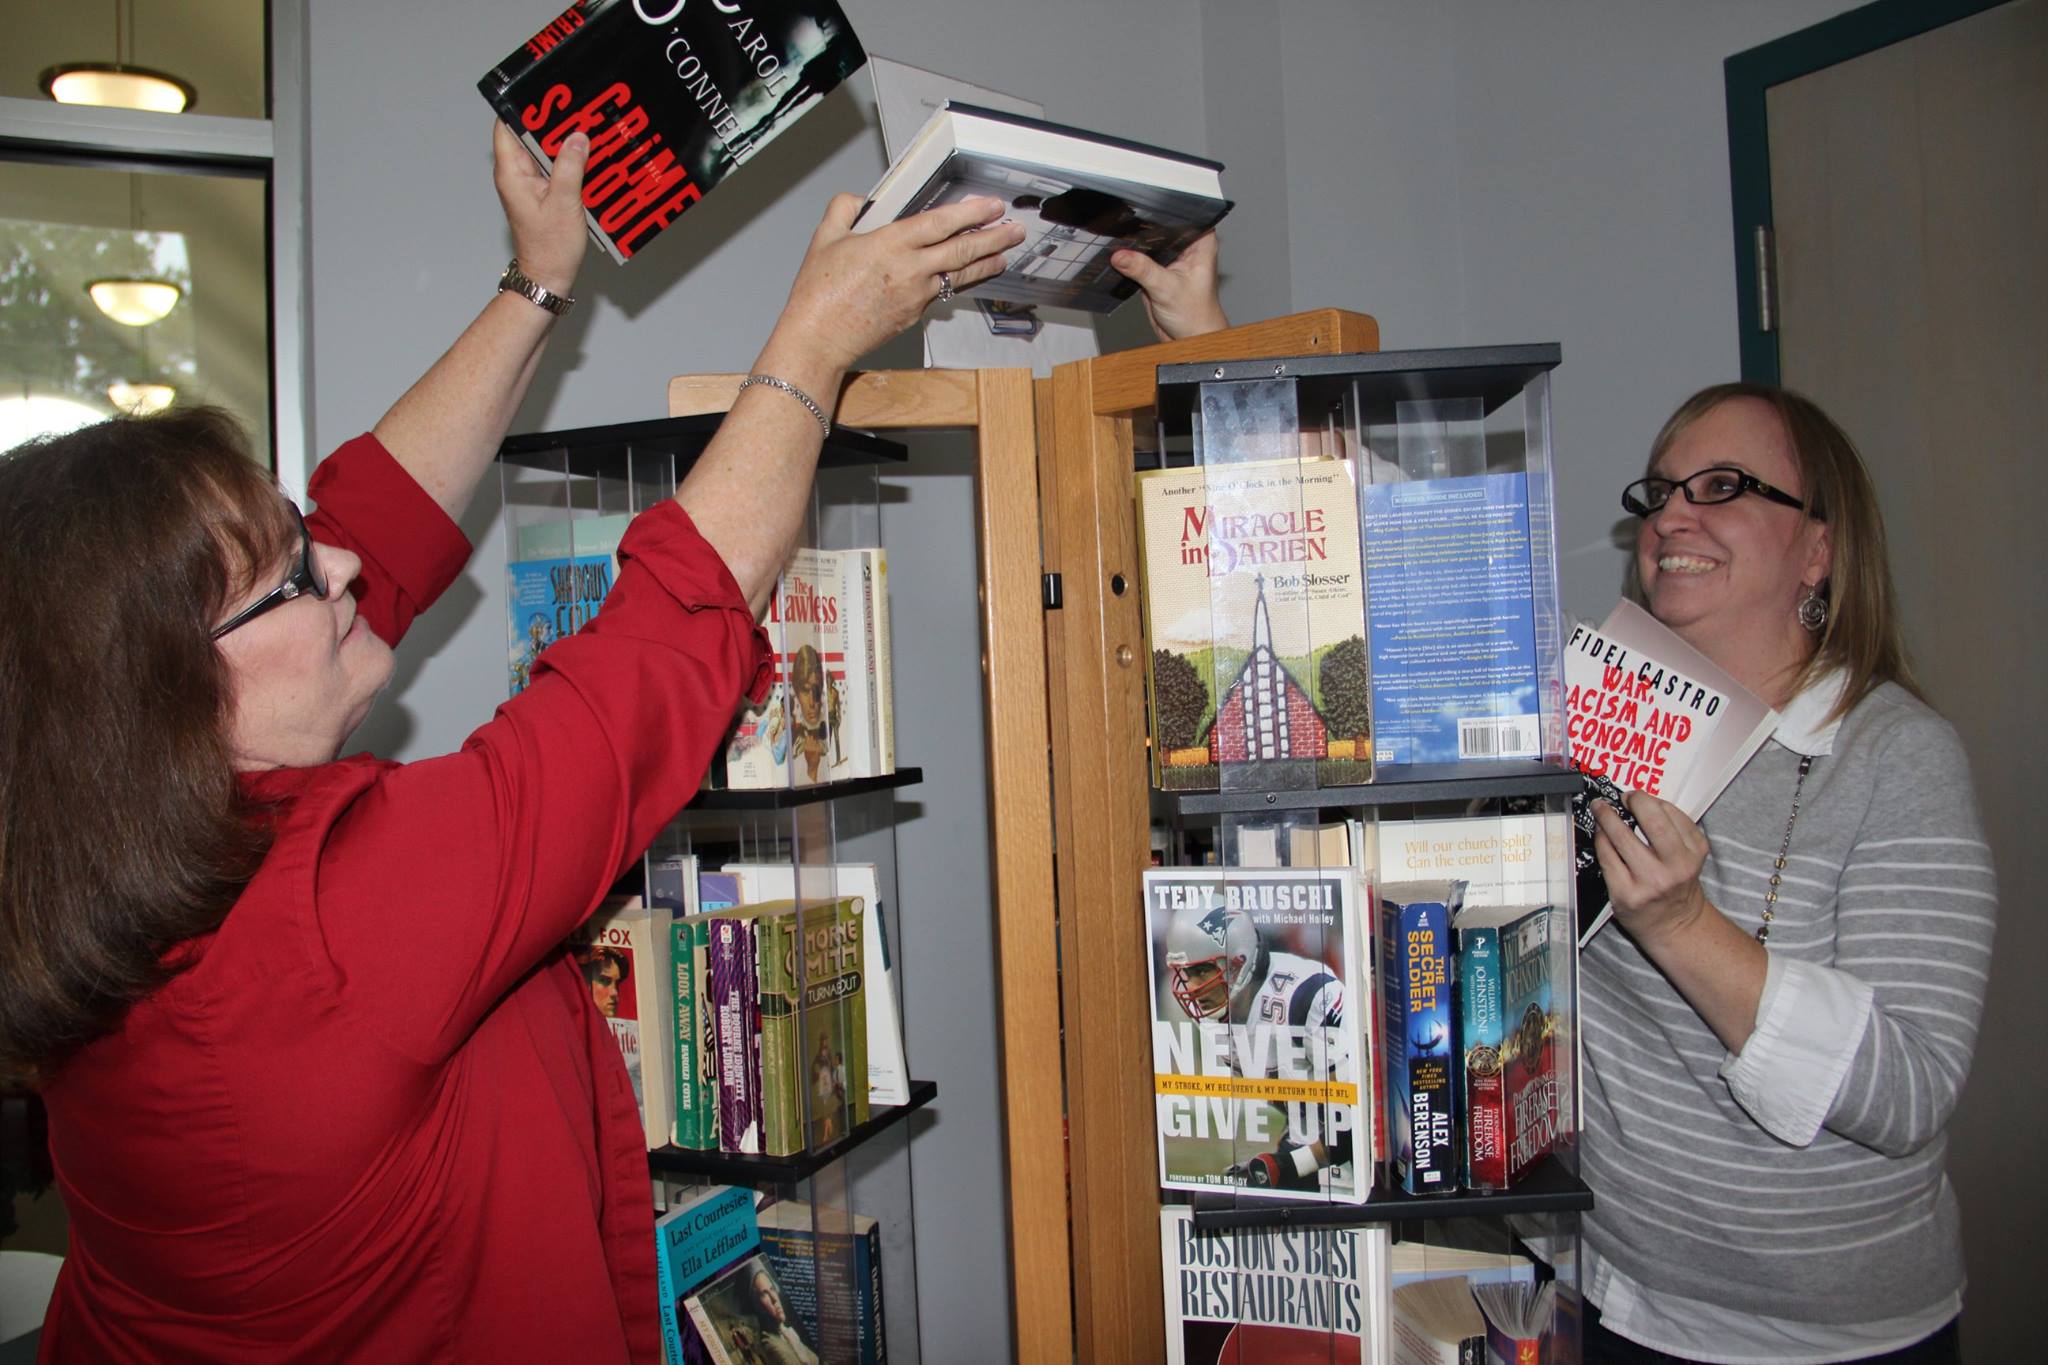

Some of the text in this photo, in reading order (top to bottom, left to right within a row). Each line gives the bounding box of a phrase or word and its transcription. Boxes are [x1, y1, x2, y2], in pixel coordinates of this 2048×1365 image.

[711, 0, 788, 97] AROL
[1161, 486, 1196, 497] Another
[1278, 477, 1292, 487] the
[1181, 506, 1327, 541] MIRACLE
[1181, 537, 1327, 577] in DARIEN
[550, 562, 610, 605] SHADOWS
[793, 577, 809, 594] The
[1274, 573, 1350, 588] Bob Slosser
[770, 584, 838, 624] Lawless
[867, 639, 875, 675] ISLAND
[1569, 628, 1627, 671] FIDEL
[1637, 661, 1720, 717] CASTRO
[1565, 685, 1692, 743] ACISM AND
[1567, 711, 1672, 766] CONOMIC
[1570, 742, 1664, 796] JUSTICE
[1405, 833, 1533, 854] Will our church split?
[1407, 856, 1431, 869] Can
[1435, 854, 1454, 868] the
[1458, 853, 1496, 866] center
[1154, 884, 1333, 911] TEDY BRUSCHI
[1252, 913, 1270, 924] with
[1273, 912, 1306, 924] Michael
[600, 928, 632, 946] FOX
[807, 975, 857, 1004] TURNABOUT
[1407, 931, 1421, 1013] SOLDIER
[1420, 930, 1436, 1010] SECRET
[1435, 956, 1445, 984] THE
[1474, 966, 1489, 1035] JOHNSTONE
[1487, 978, 1496, 1011] WILLIAM
[677, 962, 692, 1111] LOOK AWAY HAROLD COYLE
[720, 1005, 735, 1086] ROBERT LUDLUM
[731, 990, 746, 1102] THE BOURNE IDENTITY
[1153, 1021, 1340, 1082] NEVER
[1162, 1081, 1172, 1089] MY
[1205, 1083, 1214, 1091] MY
[1218, 1084, 1254, 1093] RECOVERY
[1264, 1086, 1274, 1094] MY
[1278, 1087, 1306, 1096] RETURN
[1309, 1088, 1317, 1096] TO
[1320, 1088, 1334, 1097] THE
[1336, 1089, 1349, 1098] NFL
[1160, 1094, 1353, 1147] GIVE UP
[1413, 1092, 1431, 1169] BERENSON
[1432, 1112, 1449, 1147] ALEX
[1473, 1106, 1484, 1161] FREEDOM
[1484, 1108, 1494, 1158] FIREBASE
[1169, 1174, 1196, 1182] FOREWORD
[1205, 1174, 1221, 1184] TOM
[1223, 1175, 1248, 1187] BRADY
[670, 1222, 693, 1247] Last
[694, 1192, 748, 1231] Courtesies
[681, 1255, 703, 1279] Ella
[704, 1223, 748, 1264] Leffland
[1305, 1226, 1360, 1280] BEST
[663, 1305, 672, 1326] Last
[1180, 1269, 1362, 1333] RESTAURANTS
